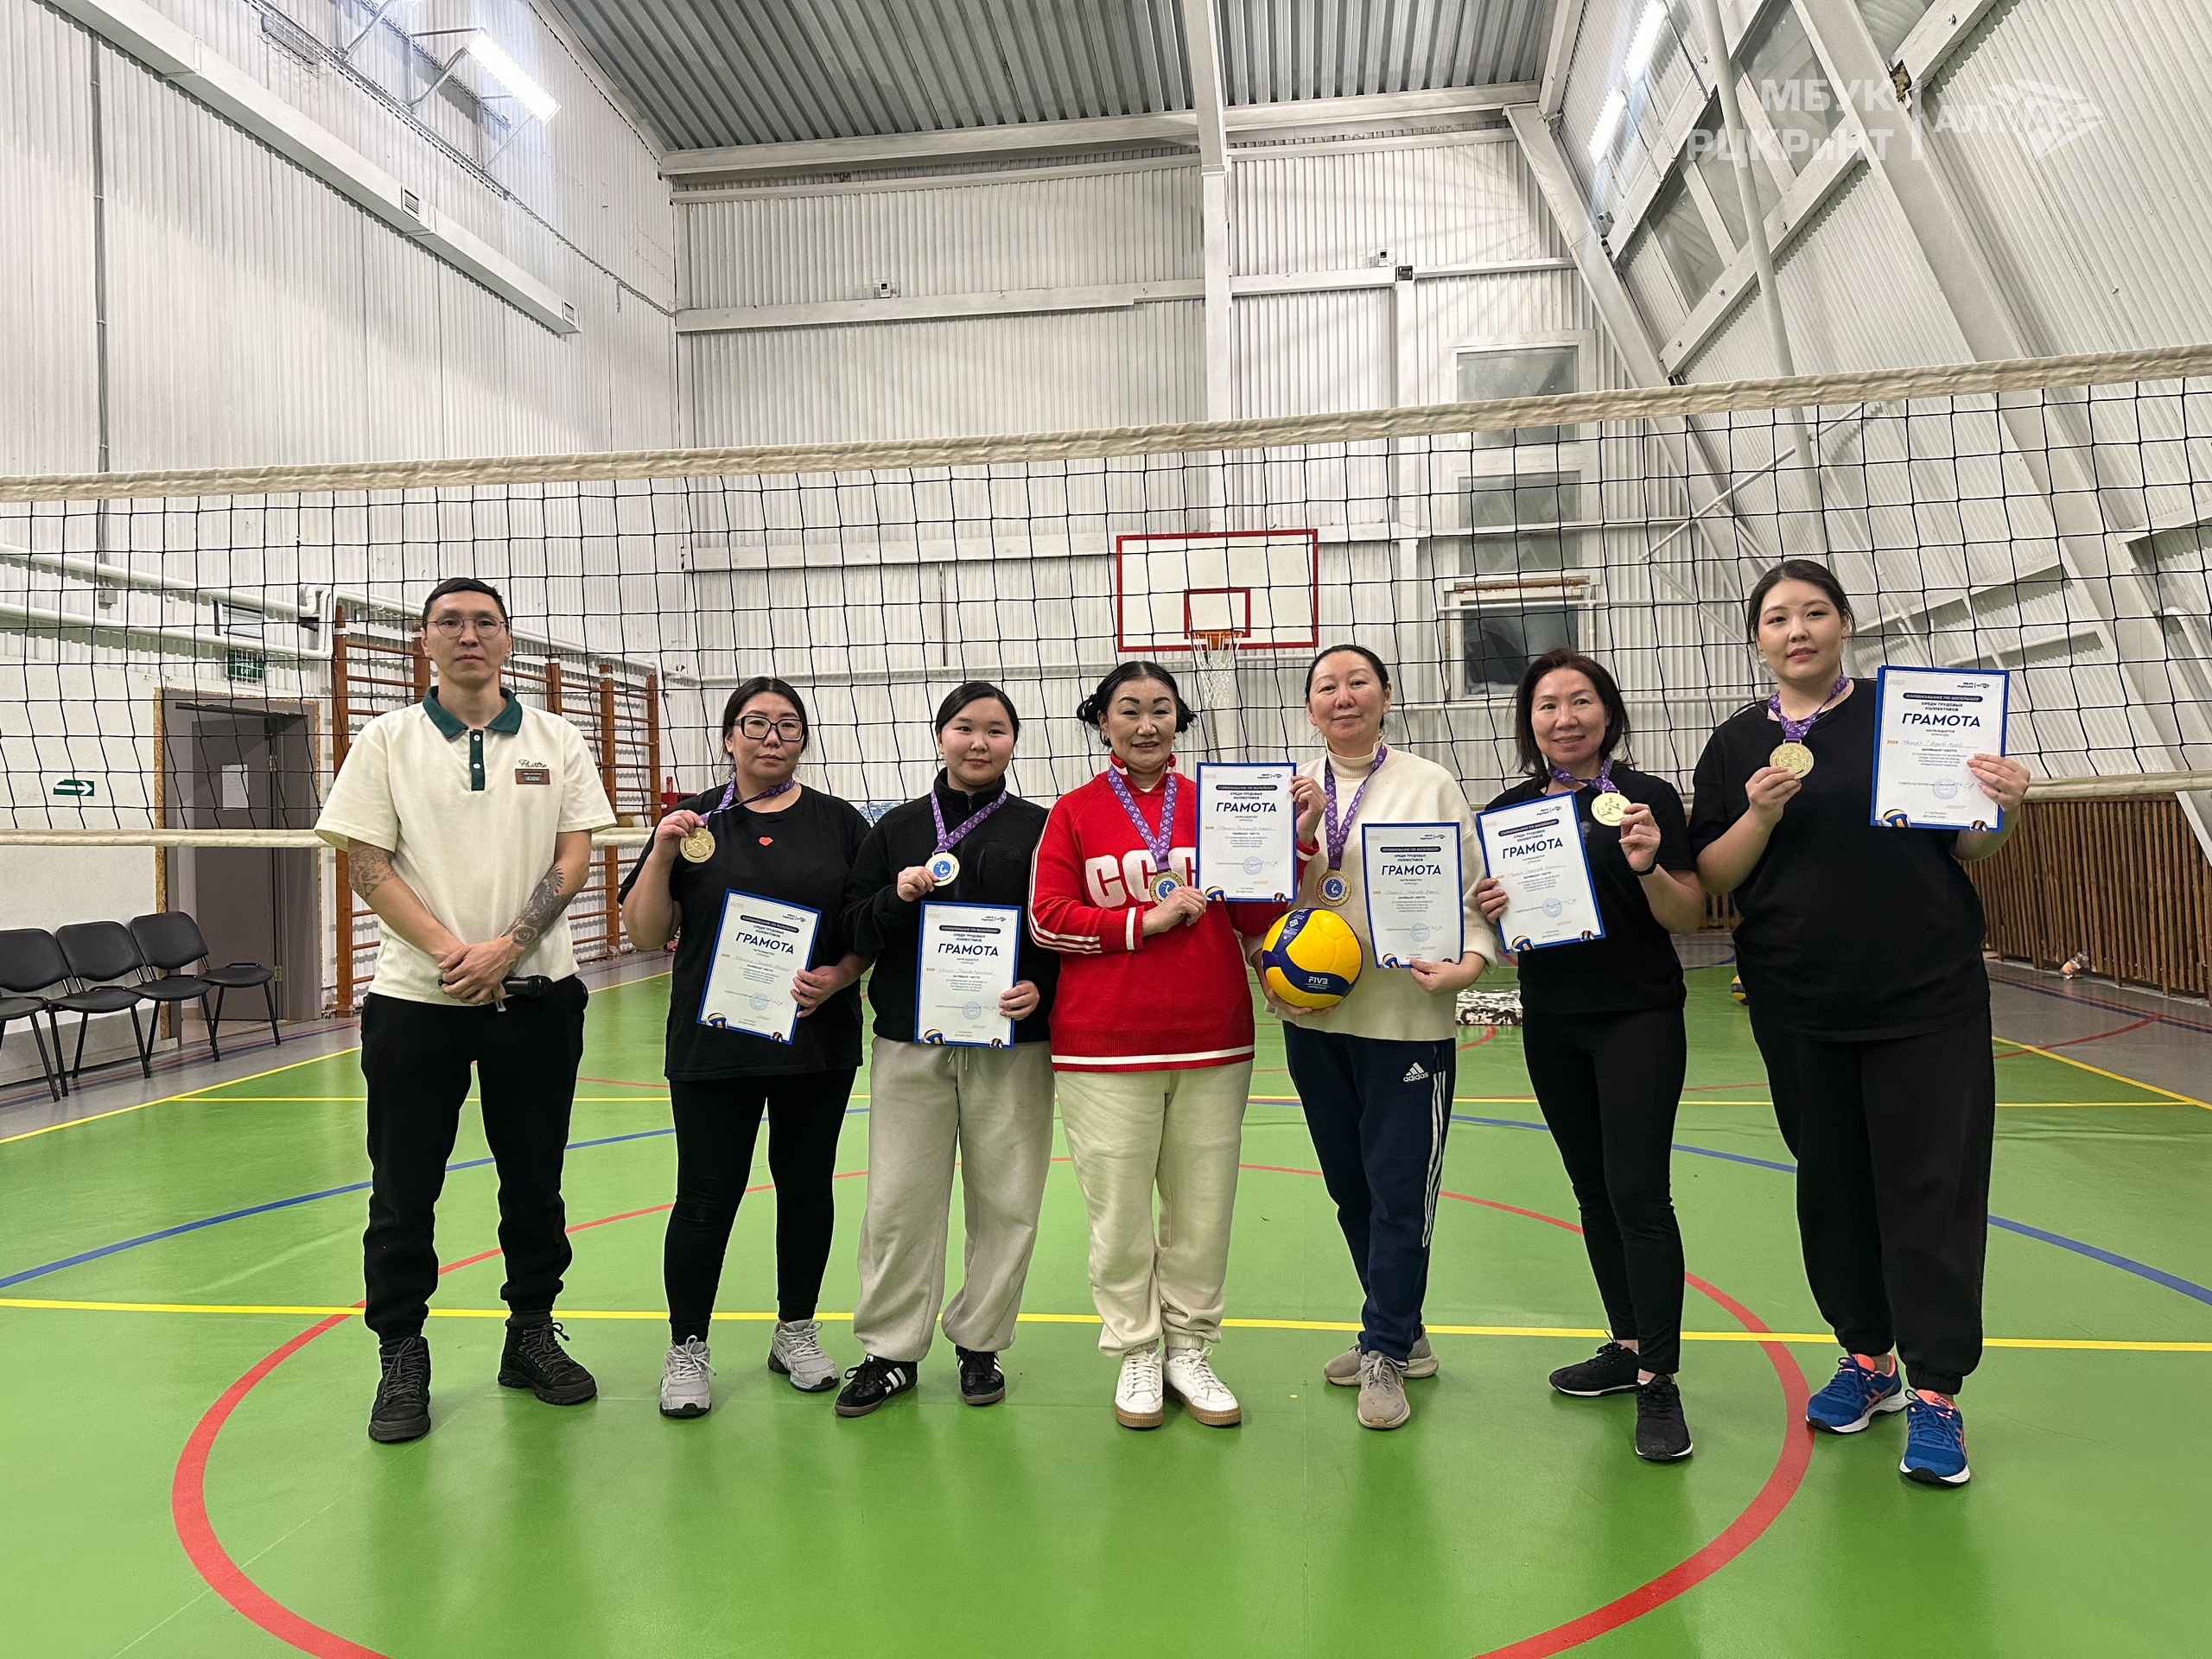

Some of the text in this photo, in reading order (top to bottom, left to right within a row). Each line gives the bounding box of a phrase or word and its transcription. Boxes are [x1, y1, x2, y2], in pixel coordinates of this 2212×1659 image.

[1902, 713, 1980, 727] ГРАМОТА
[1216, 802, 1277, 812] ГРАМОТА
[1503, 837, 1563, 859] ГРАМОТА
[1382, 865, 1441, 875] ГРАМОТА
[1085, 847, 1196, 908] ССС
[735, 932, 794, 954] ГРАМОТА
[938, 943, 999, 957] ГРАМОТА
[1403, 1071, 1429, 1083] adidas
